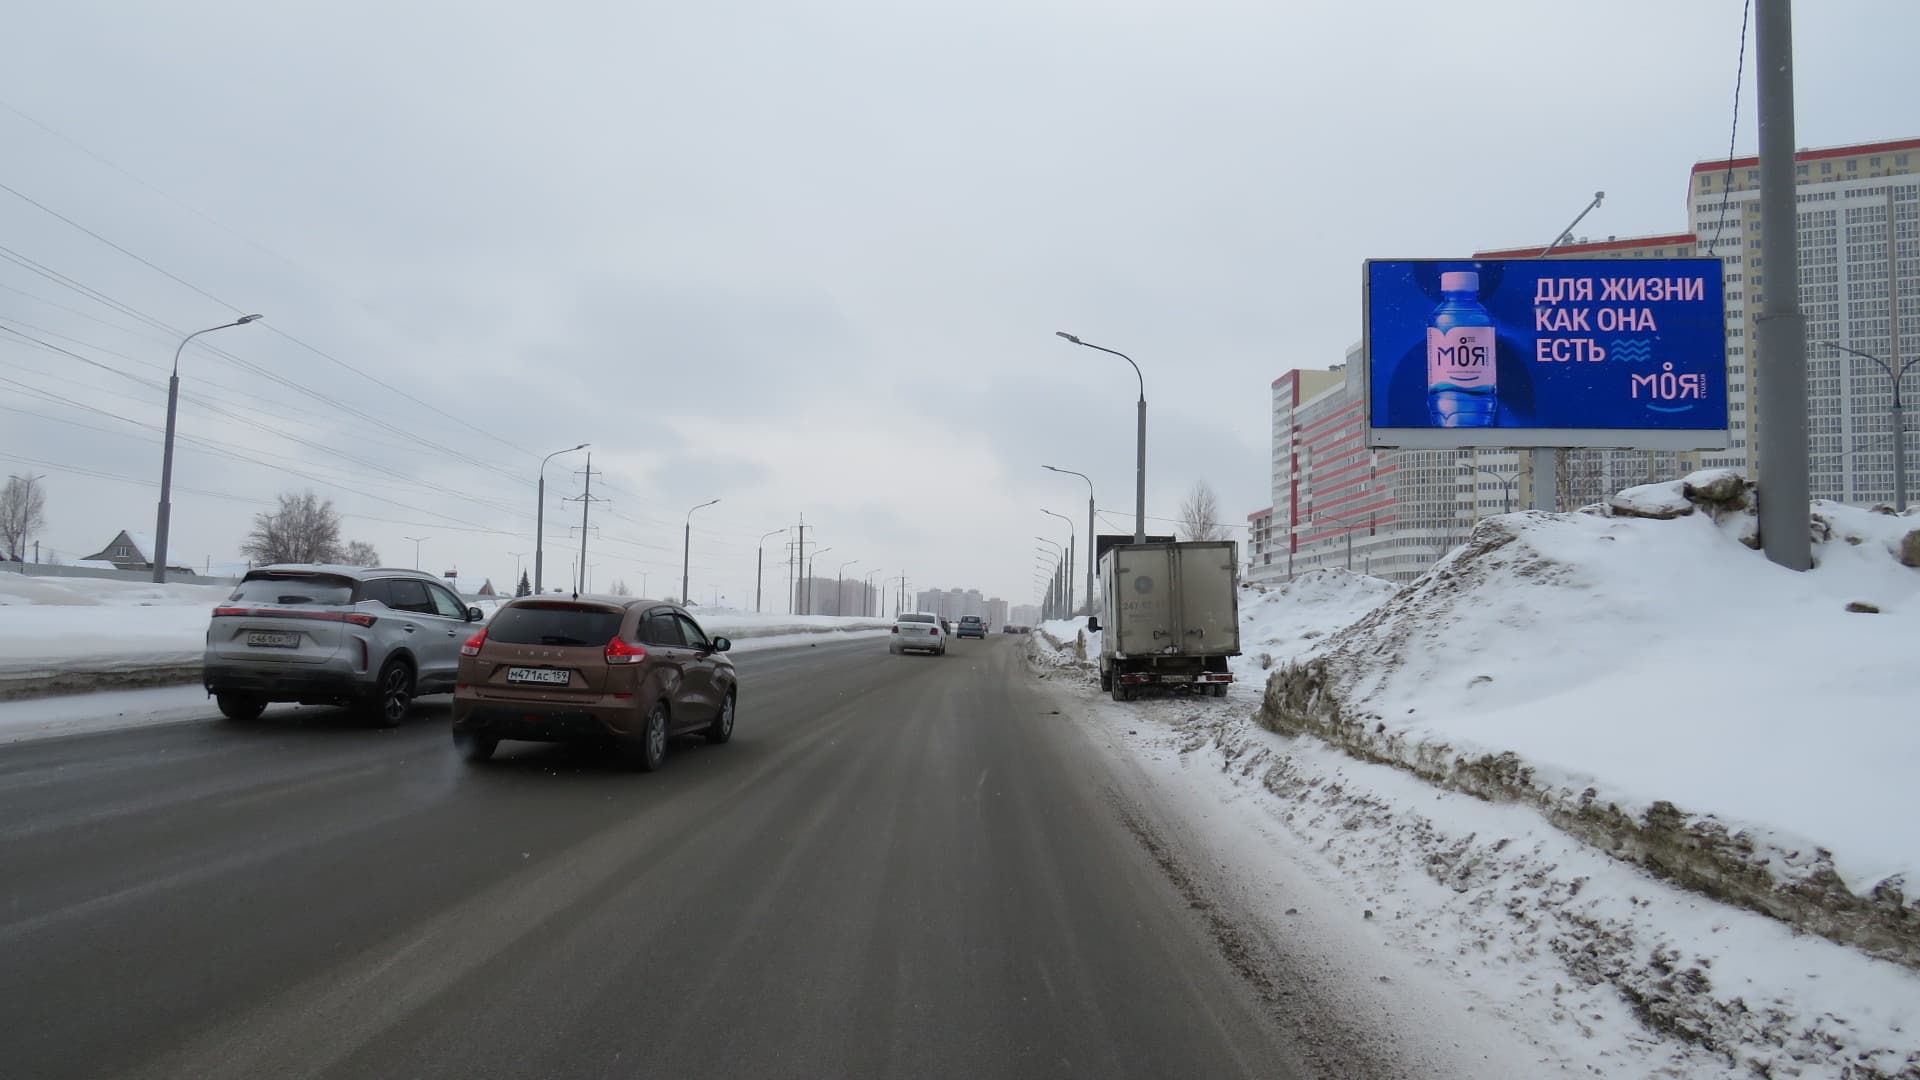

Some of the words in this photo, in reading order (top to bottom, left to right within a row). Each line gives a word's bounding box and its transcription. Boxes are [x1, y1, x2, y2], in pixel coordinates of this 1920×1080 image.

[1534, 278, 1593, 305] ДЛЯ
[1600, 278, 1704, 301] ЖИЗНИ
[1536, 308, 1591, 331] КАК
[1596, 308, 1657, 332] ОНА
[1536, 338, 1606, 362] ЕСТЬ
